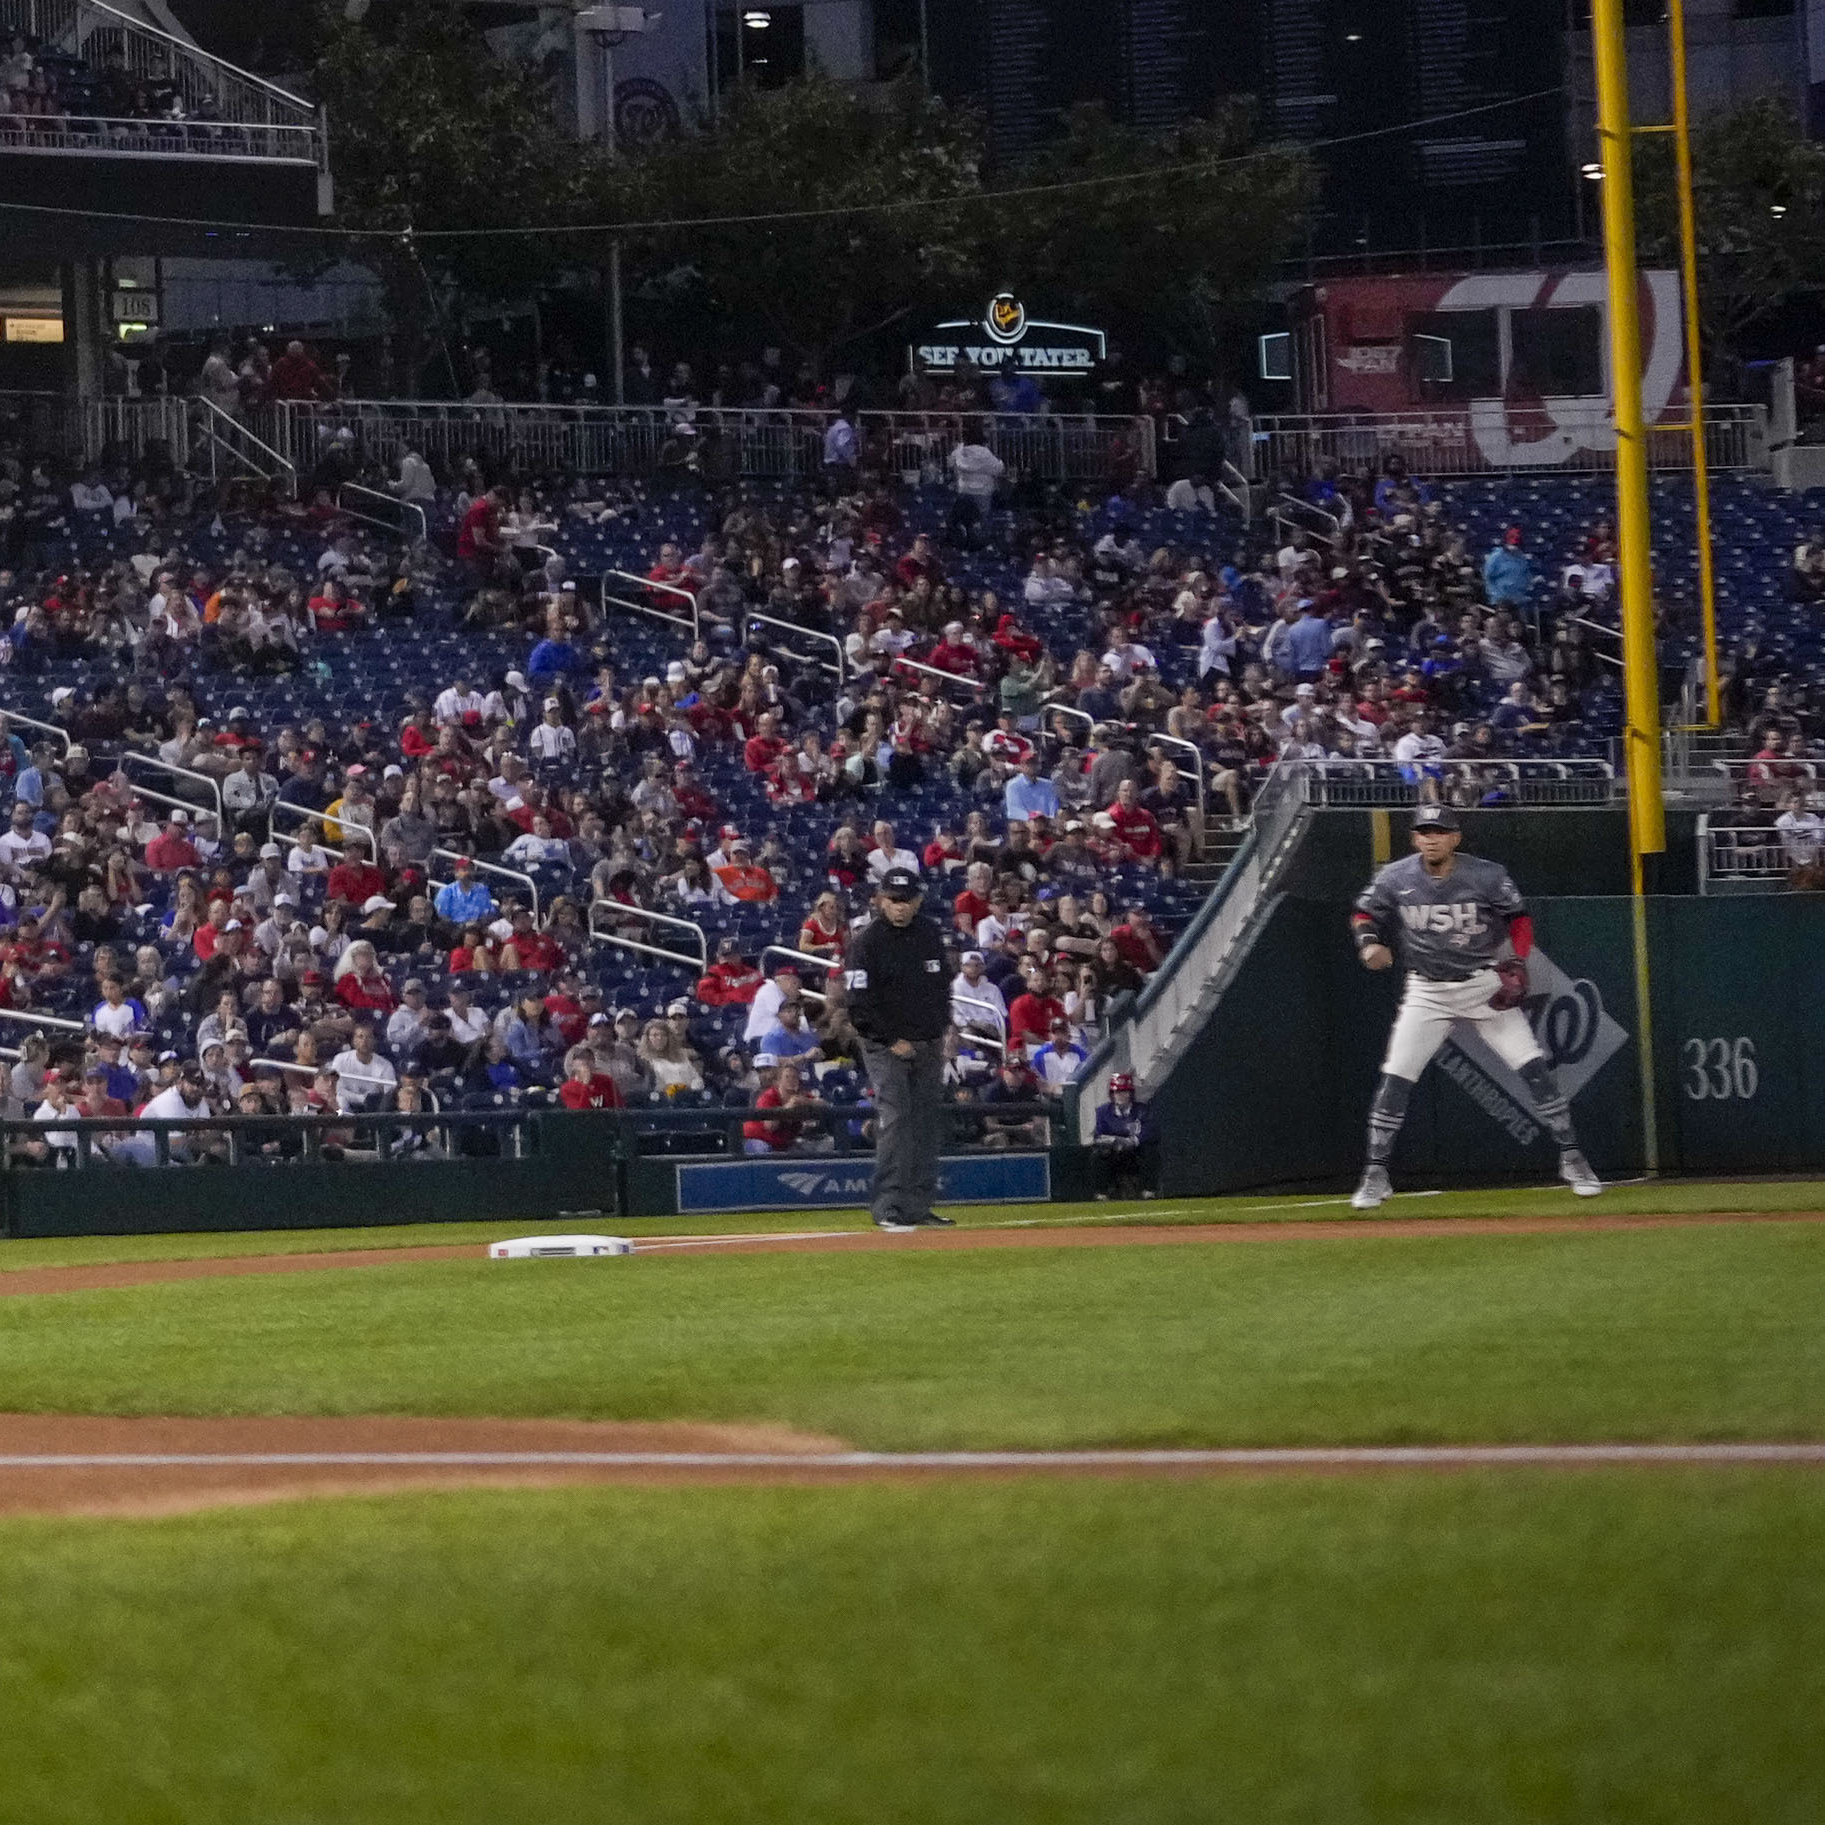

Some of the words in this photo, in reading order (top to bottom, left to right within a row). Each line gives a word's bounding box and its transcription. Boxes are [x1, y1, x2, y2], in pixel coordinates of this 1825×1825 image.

[122, 297, 150, 317] 108
[1400, 903, 1481, 934] WSH
[844, 969, 868, 990] 72
[1684, 1037, 1758, 1099] 336
